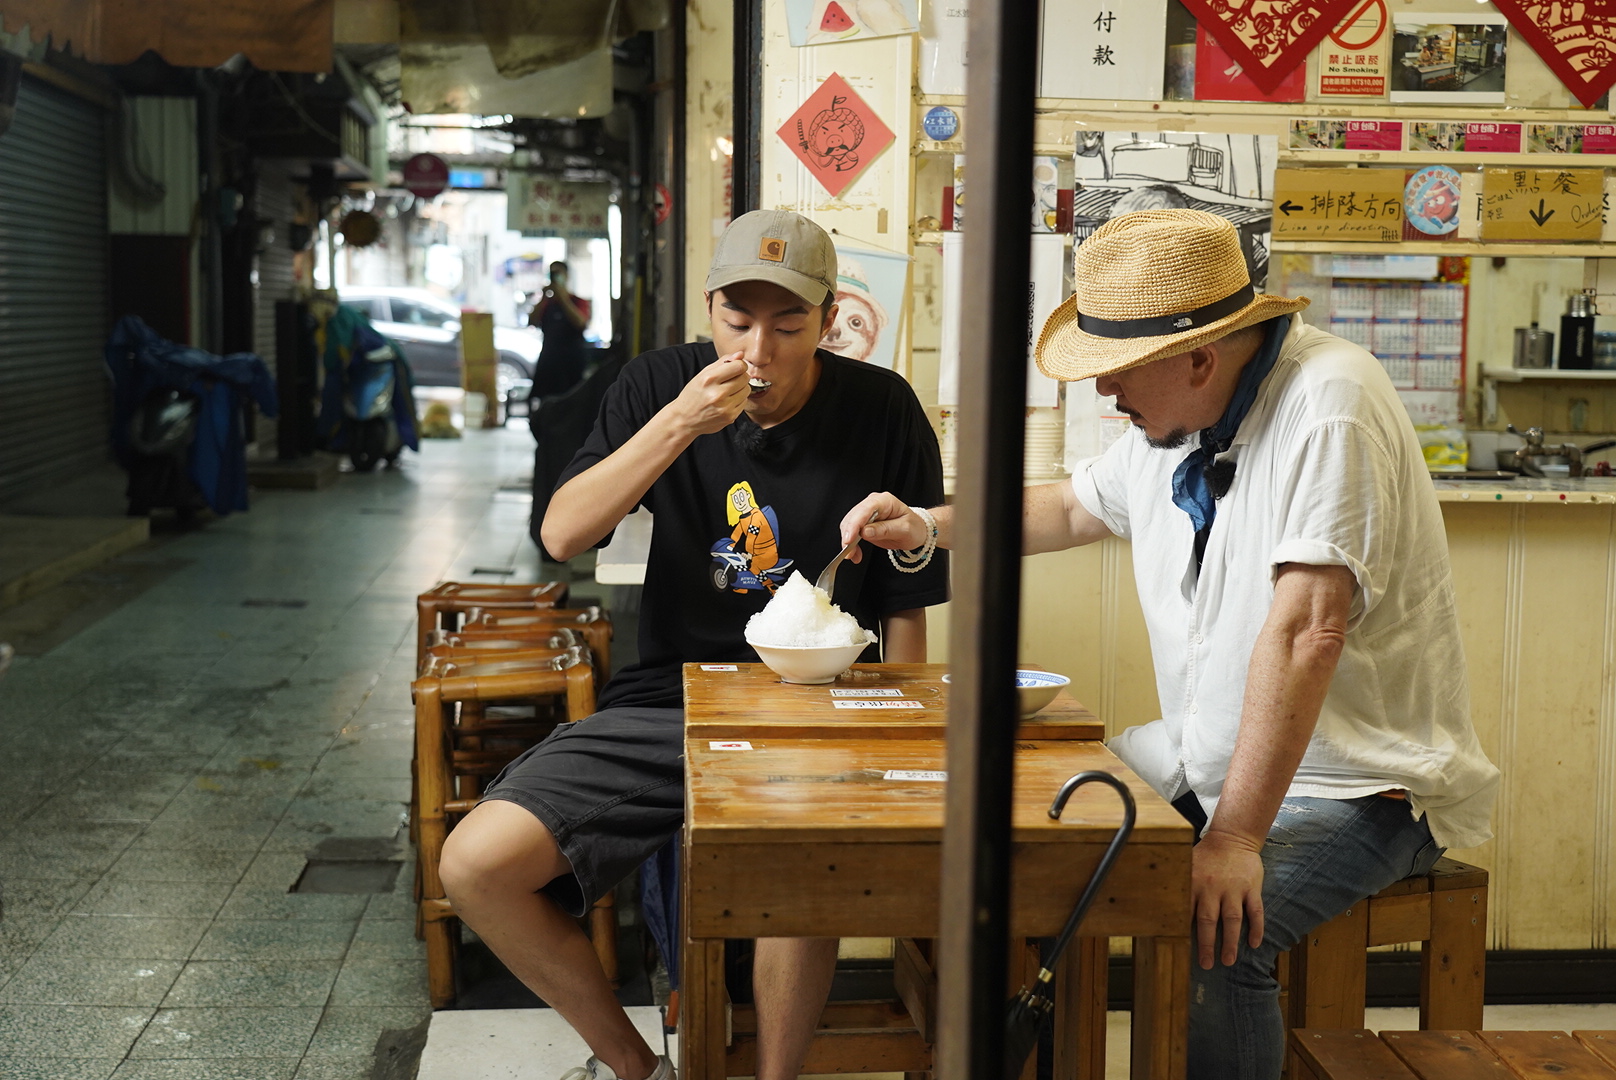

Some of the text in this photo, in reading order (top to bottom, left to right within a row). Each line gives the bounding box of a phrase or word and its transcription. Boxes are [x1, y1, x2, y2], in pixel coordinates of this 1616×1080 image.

[1093, 11, 1117, 66] 付款
[1328, 54, 1379, 65] 禁止吸菸
[1342, 66, 1379, 74] Smoking
[1351, 78, 1383, 86] NT$10,000
[1310, 190, 1401, 221] 排隊方向
[1571, 202, 1602, 223] Order
[1279, 222, 1389, 236] Line up direction
